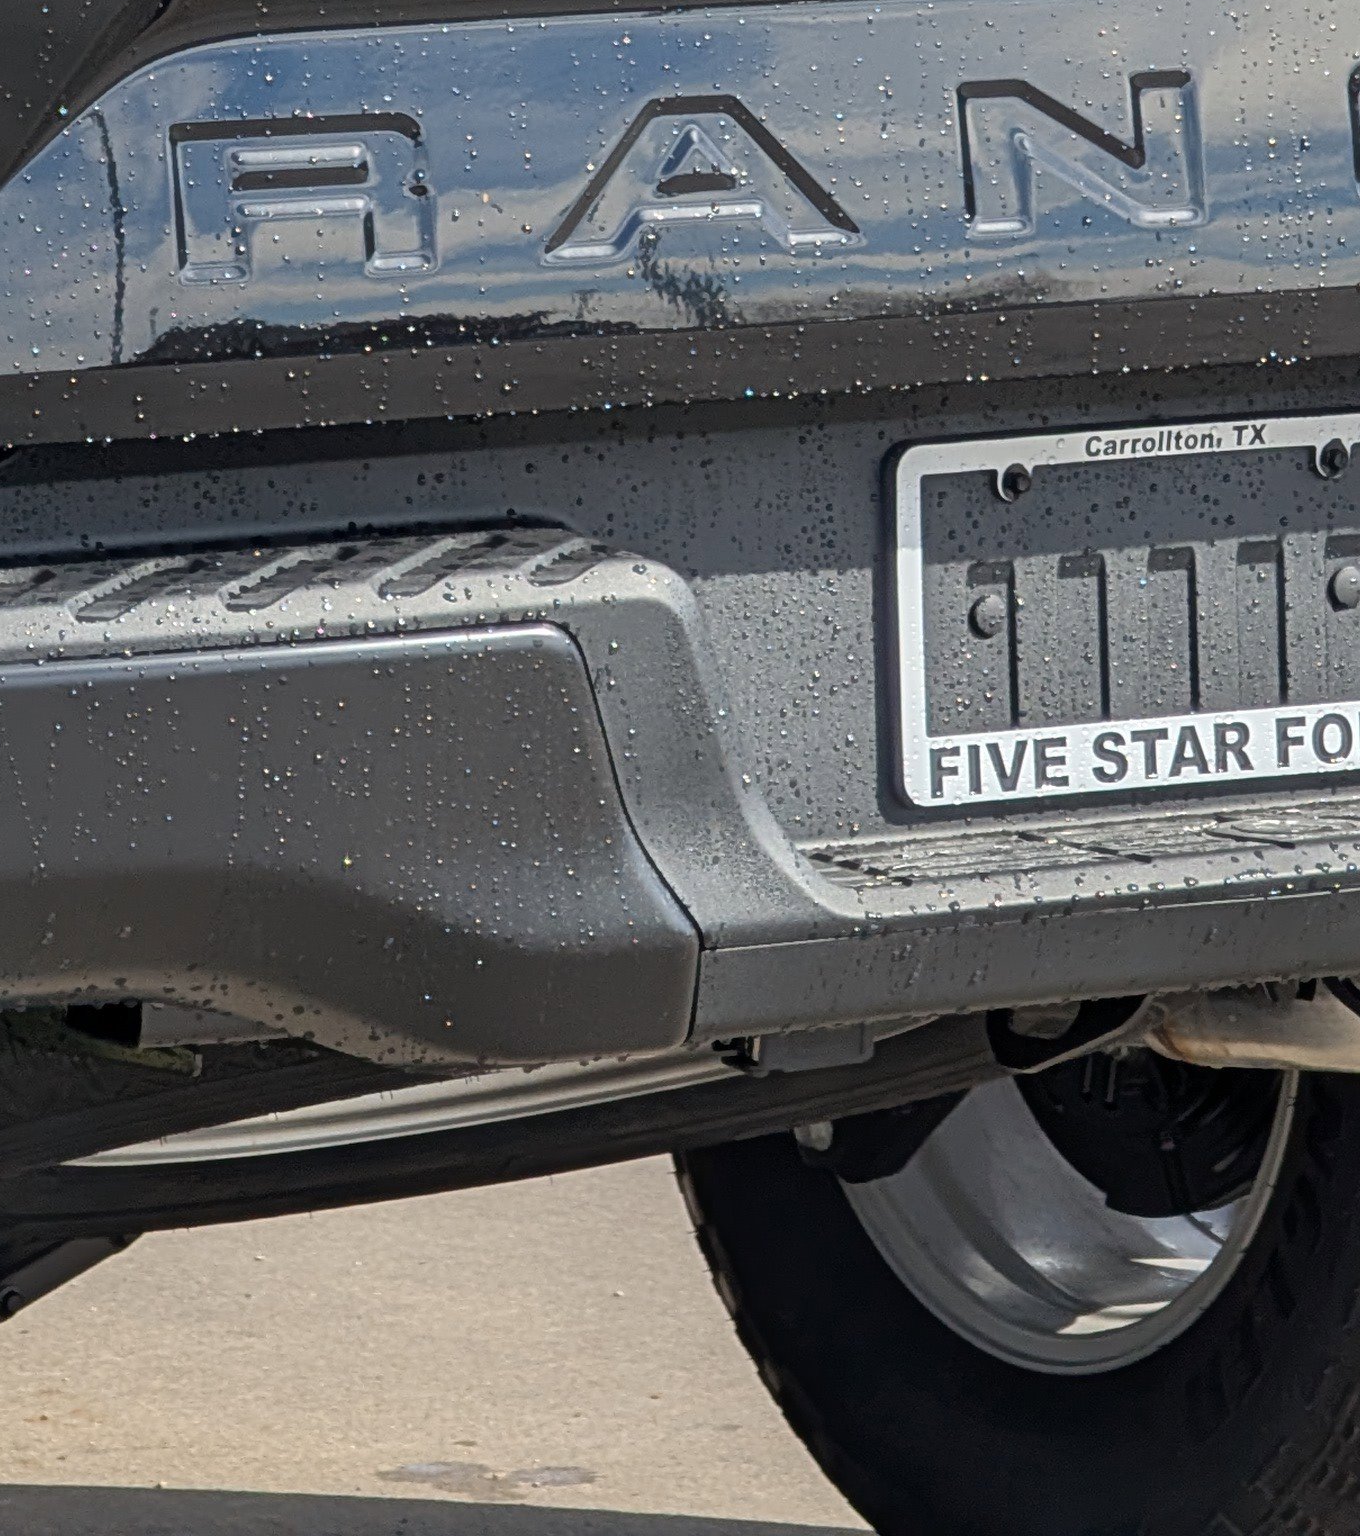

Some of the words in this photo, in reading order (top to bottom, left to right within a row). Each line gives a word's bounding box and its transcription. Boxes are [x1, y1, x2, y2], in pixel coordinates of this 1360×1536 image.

[1085, 429, 1222, 457] Carrollton,
[1233, 424, 1267, 446] TX
[928, 737, 1069, 799] FIVE
[1092, 722, 1253, 784] STAR
